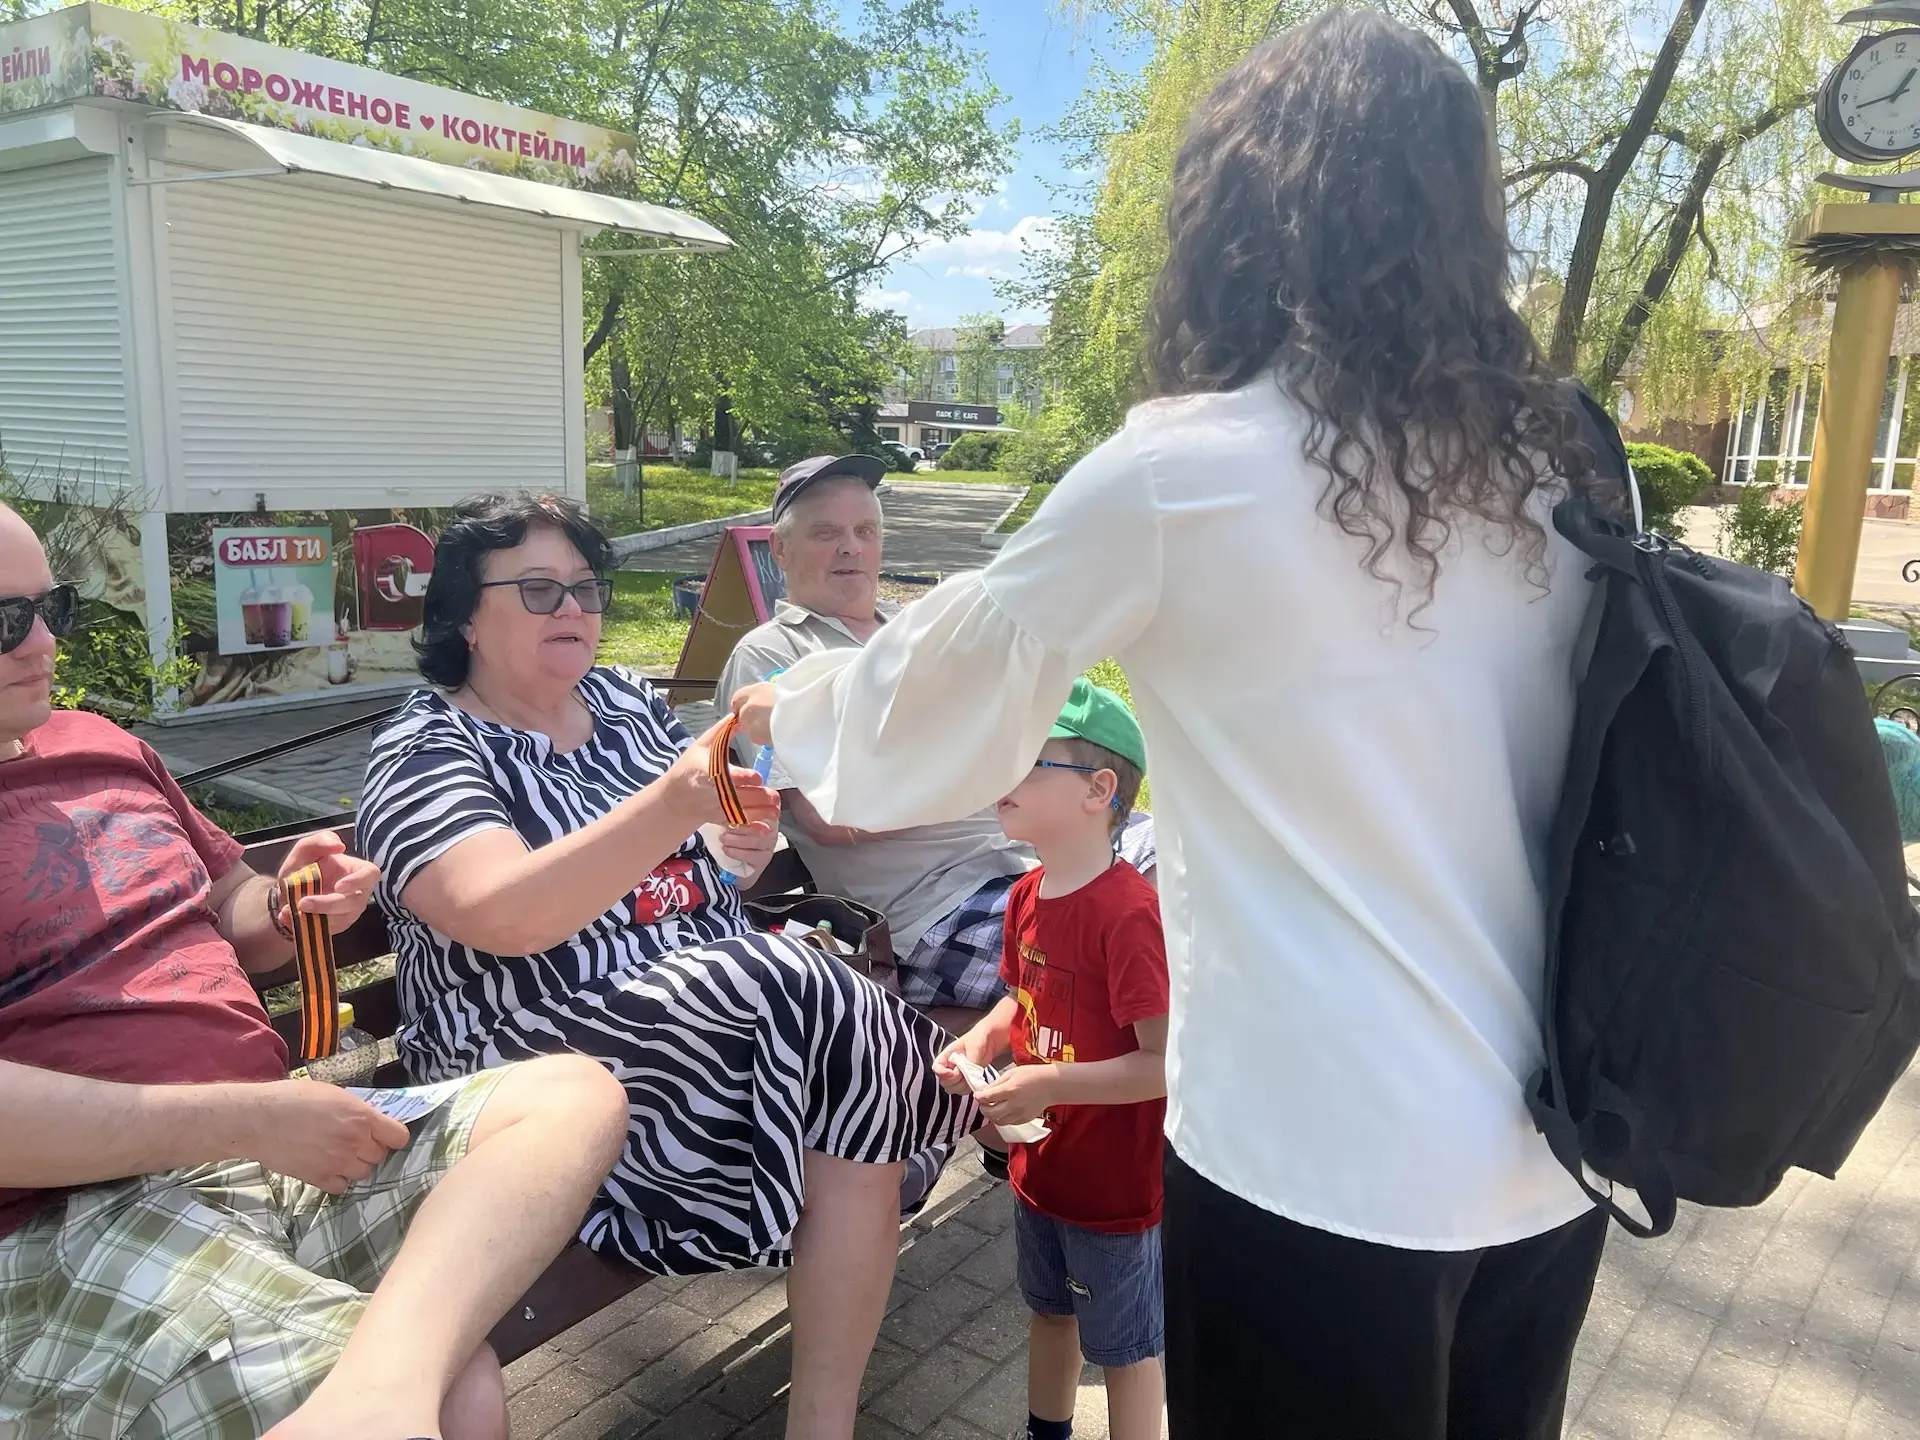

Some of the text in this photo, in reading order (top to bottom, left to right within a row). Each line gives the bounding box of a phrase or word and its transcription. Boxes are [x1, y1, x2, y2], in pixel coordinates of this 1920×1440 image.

[1895, 42, 1906, 54] 12
[1870, 51, 1879, 62] 11
[2, 45, 50, 84] ЕЙЛИ
[1849, 69, 1861, 81] 10
[1841, 93, 1848, 104] 9
[181, 54, 586, 169] МОРОЖЕНОЕ КОКТЕЙЛИ
[1847, 116, 1855, 127] 8
[1864, 132, 1872, 143] 7
[1887, 136, 1895, 147] 6
[226, 538, 322, 562] БАБЛ ТИ
